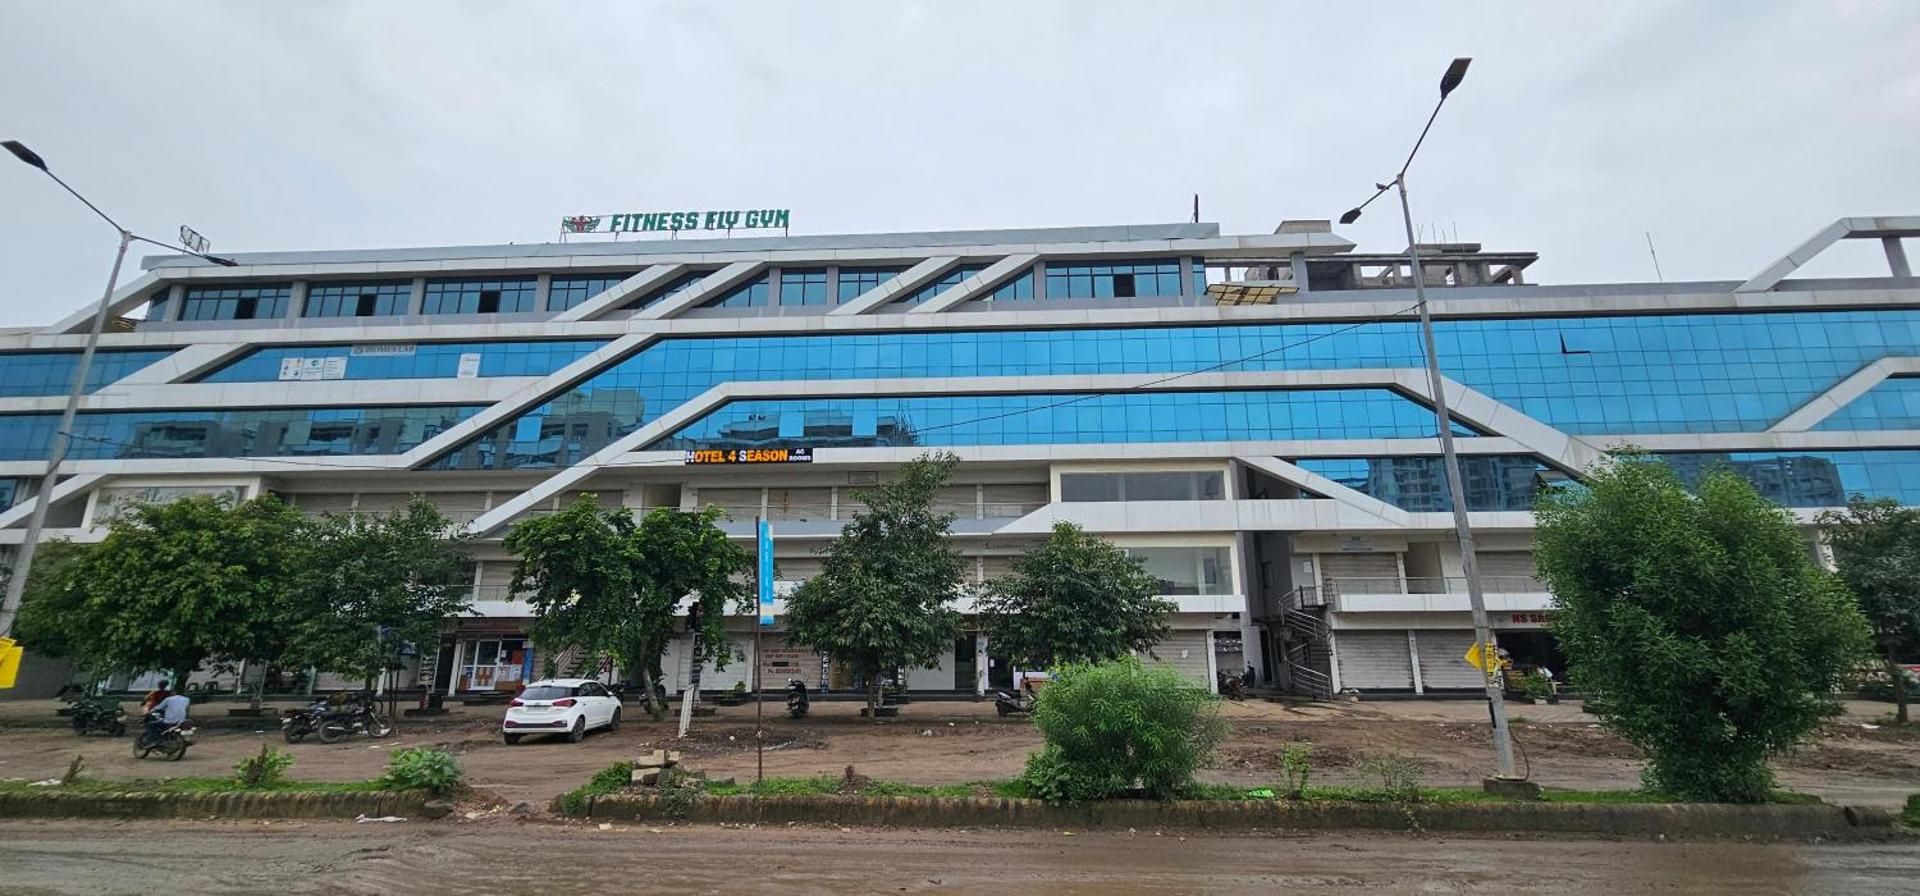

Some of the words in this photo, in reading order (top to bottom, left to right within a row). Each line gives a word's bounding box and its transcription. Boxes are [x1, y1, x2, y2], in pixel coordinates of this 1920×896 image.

[610, 211, 699, 232] FITNESS
[705, 210, 739, 229] FLY
[745, 209, 790, 228] GYM
[686, 449, 725, 462] HOTEL
[728, 450, 736, 462] 4
[739, 449, 788, 462] SEASON
